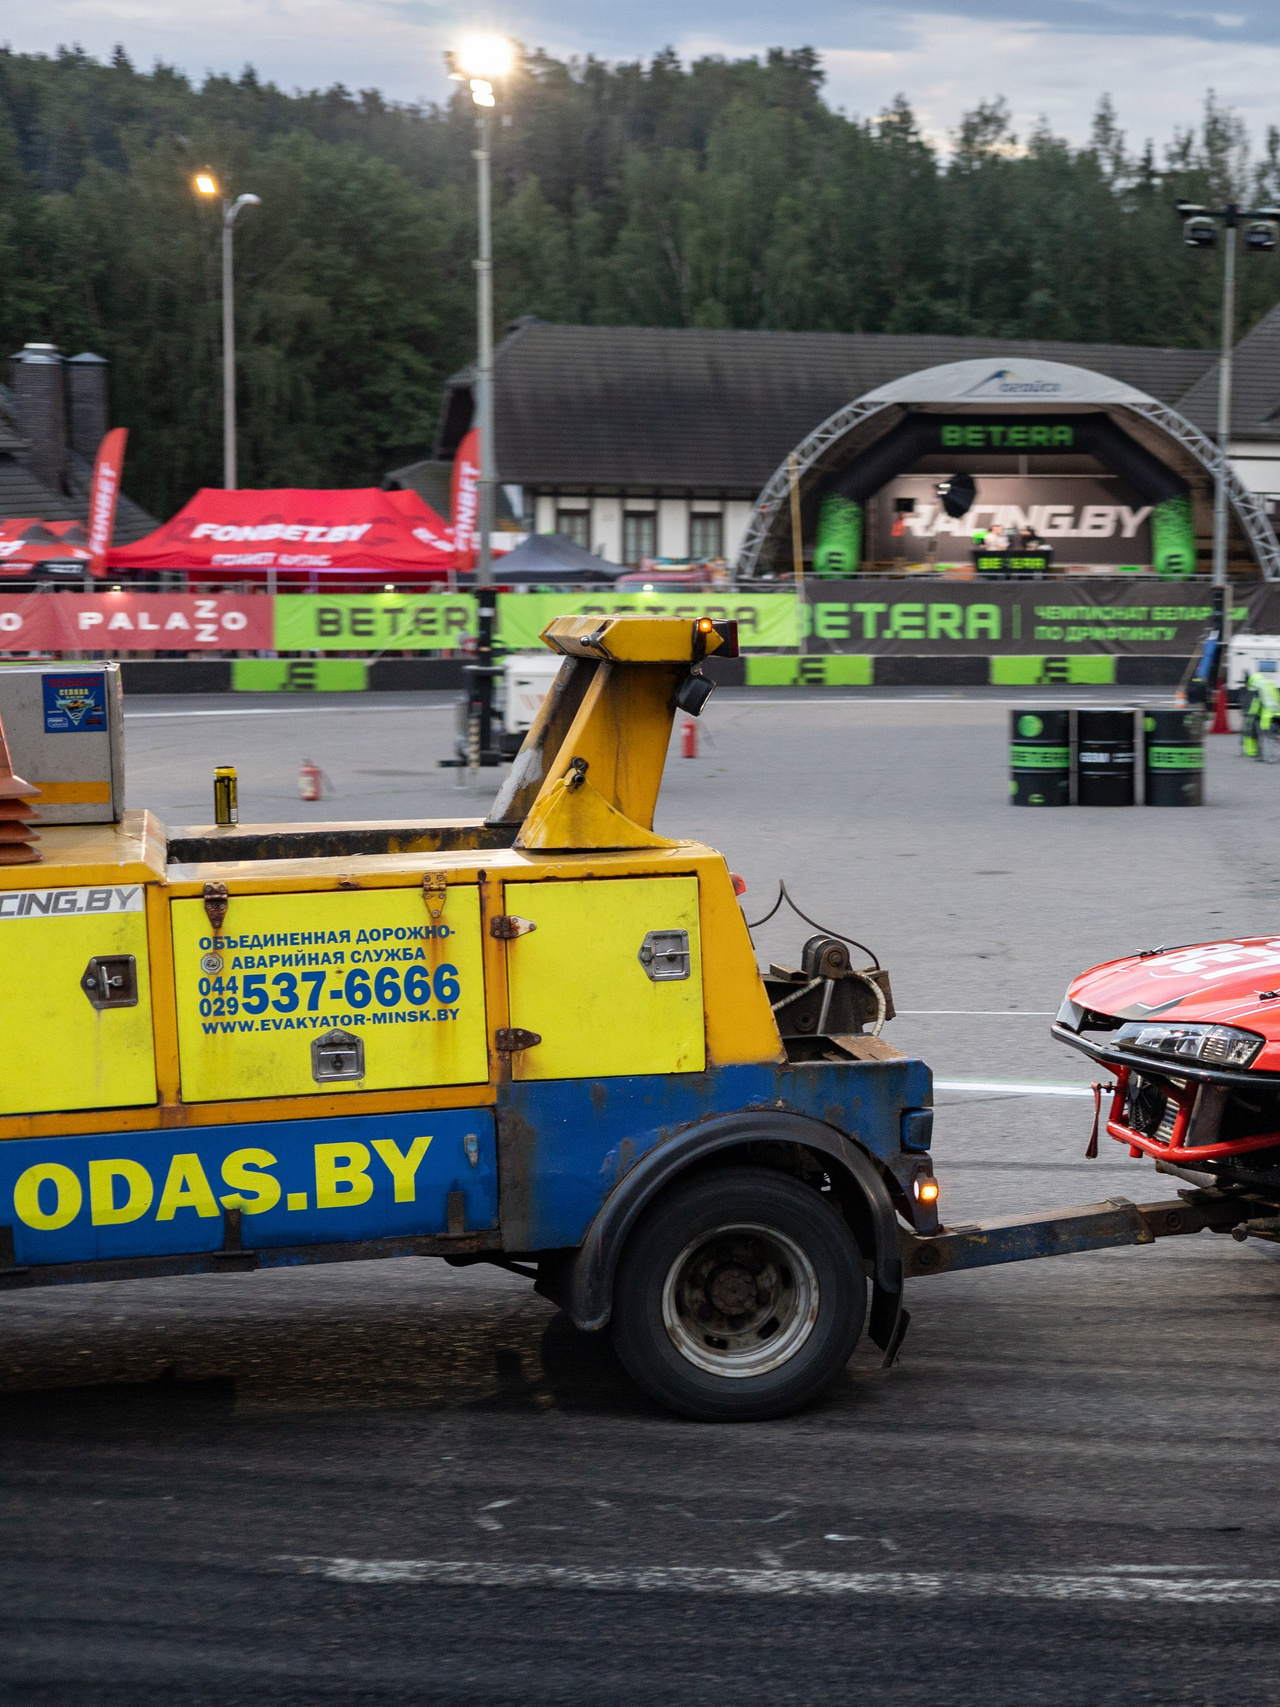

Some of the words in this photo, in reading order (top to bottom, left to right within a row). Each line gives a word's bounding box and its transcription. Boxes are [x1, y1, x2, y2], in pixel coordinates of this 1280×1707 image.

[1034, 626, 1064, 640] ПО
[199, 930, 351, 950] ОБЪЕДИНЕННАЯ
[356, 925, 456, 945] ДОРОЖНО-
[231, 949, 345, 970] АВАРИЙНАЯ
[350, 946, 426, 963] СЛУЖБА
[198, 976, 239, 997] 044
[241, 963, 460, 1015] 537-6666
[199, 997, 239, 1017] 029
[202, 1008, 460, 1034] WWW.EVAKYATOR-MINSK.BY
[13, 1136, 434, 1231] ODAS.BY
